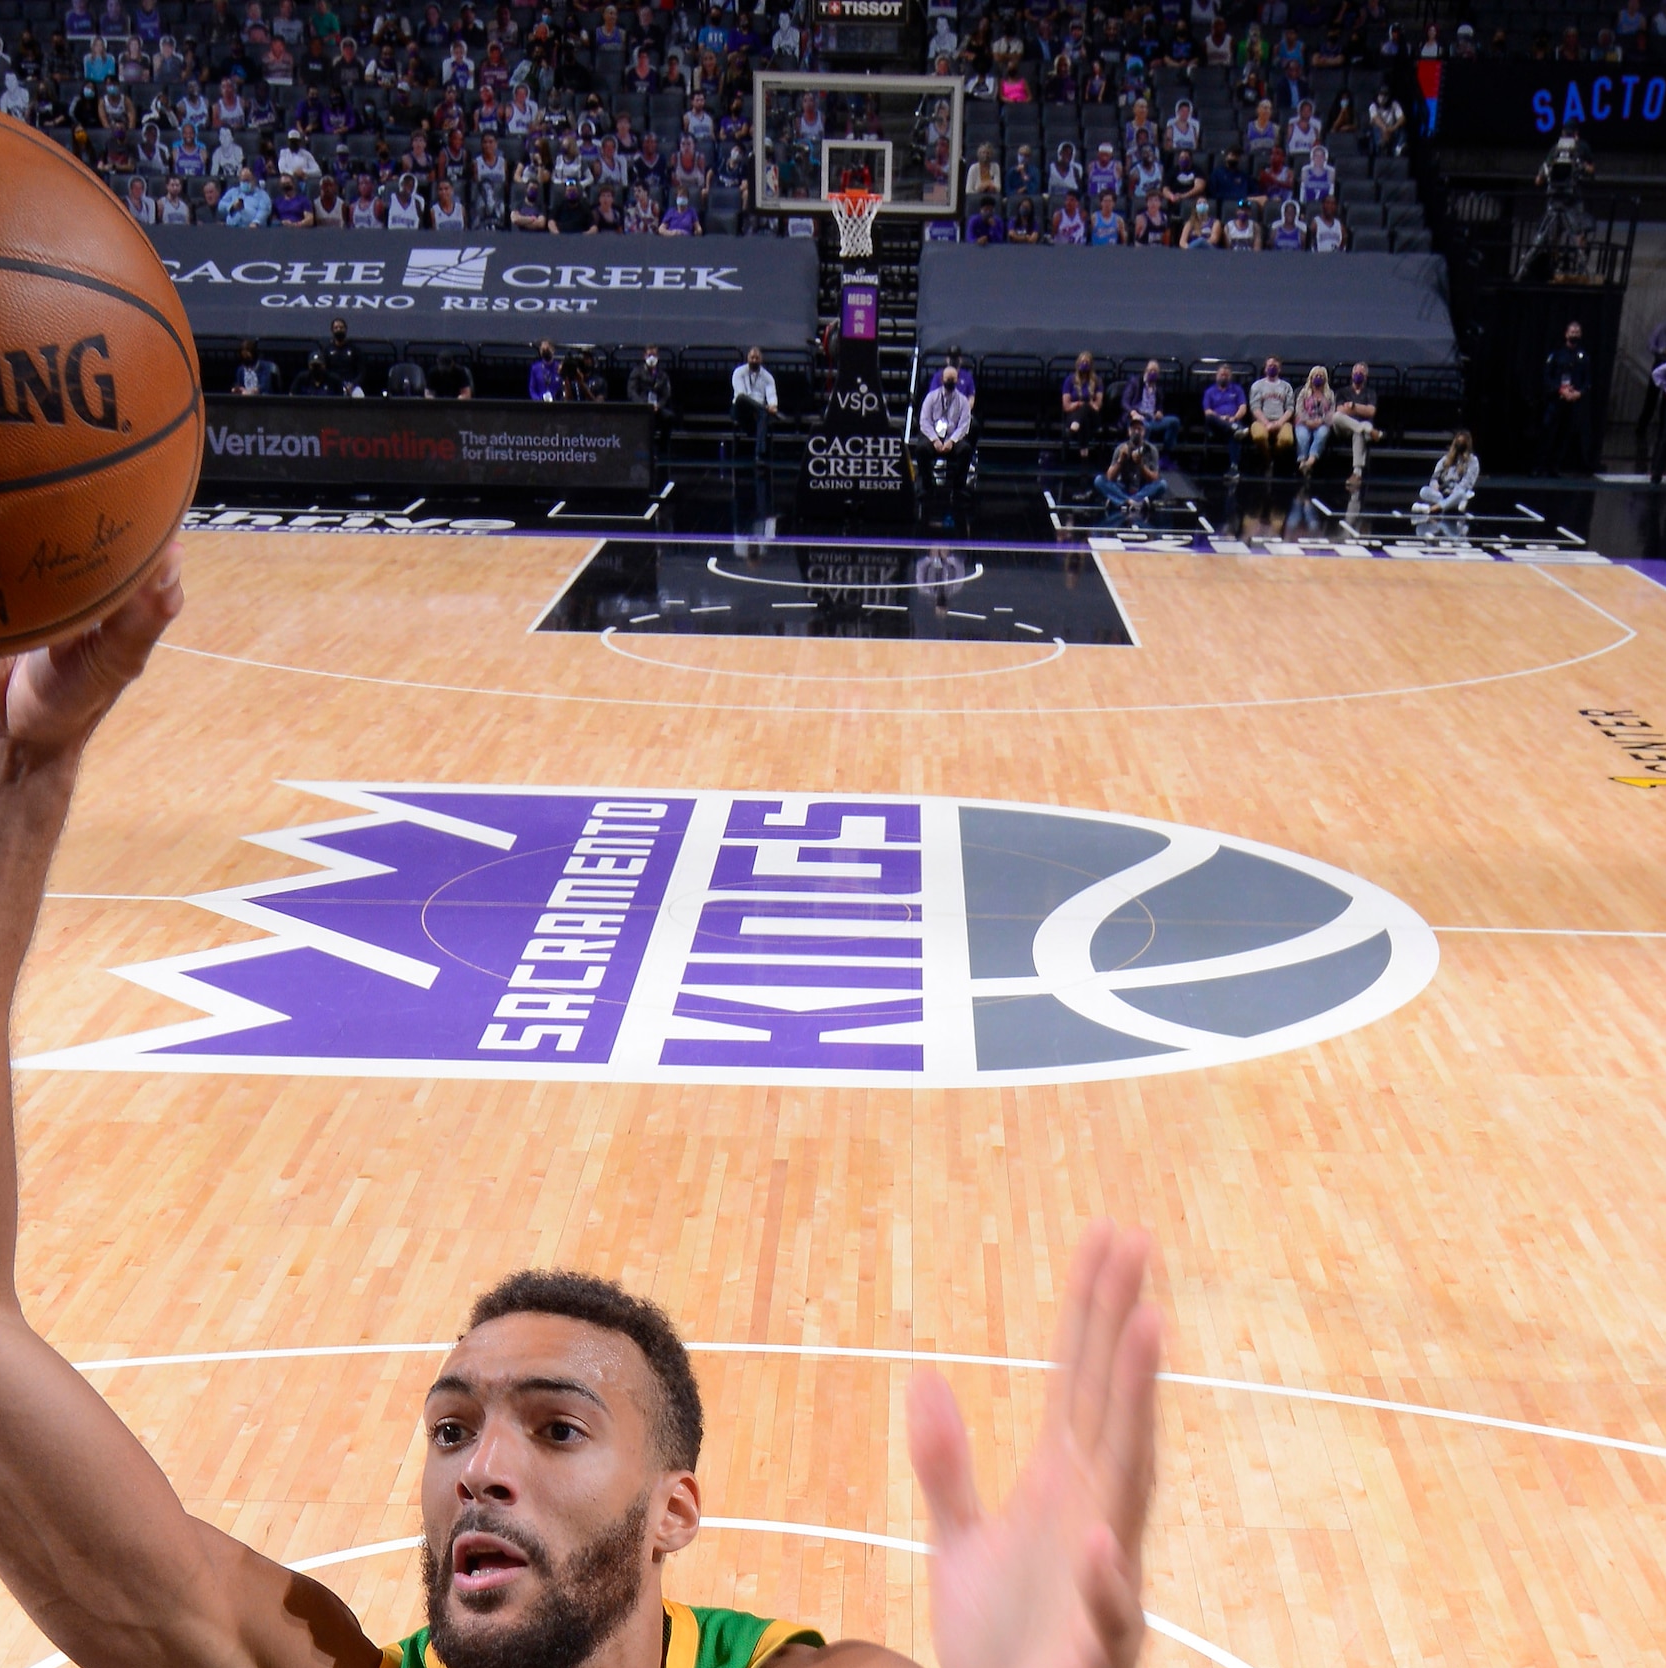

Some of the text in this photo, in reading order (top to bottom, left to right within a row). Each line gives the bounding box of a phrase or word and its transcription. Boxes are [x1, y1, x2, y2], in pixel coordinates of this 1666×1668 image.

[844, 2, 903, 16] TISSOT
[502, 264, 743, 291] CREEK
[260, 294, 598, 314] CASINO RESORT
[459, 430, 621, 450] The advanced network
[808, 435, 902, 457] CACHE
[462, 446, 598, 465] for first responders
[808, 457, 902, 478] CREEK
[809, 479, 903, 491] CASINO RESORT
[179, 523, 256, 533] AISER
[181, 510, 517, 530] thrive
[477, 801, 669, 1053] SACRAMENTO
[658, 797, 924, 1073] KINGS
